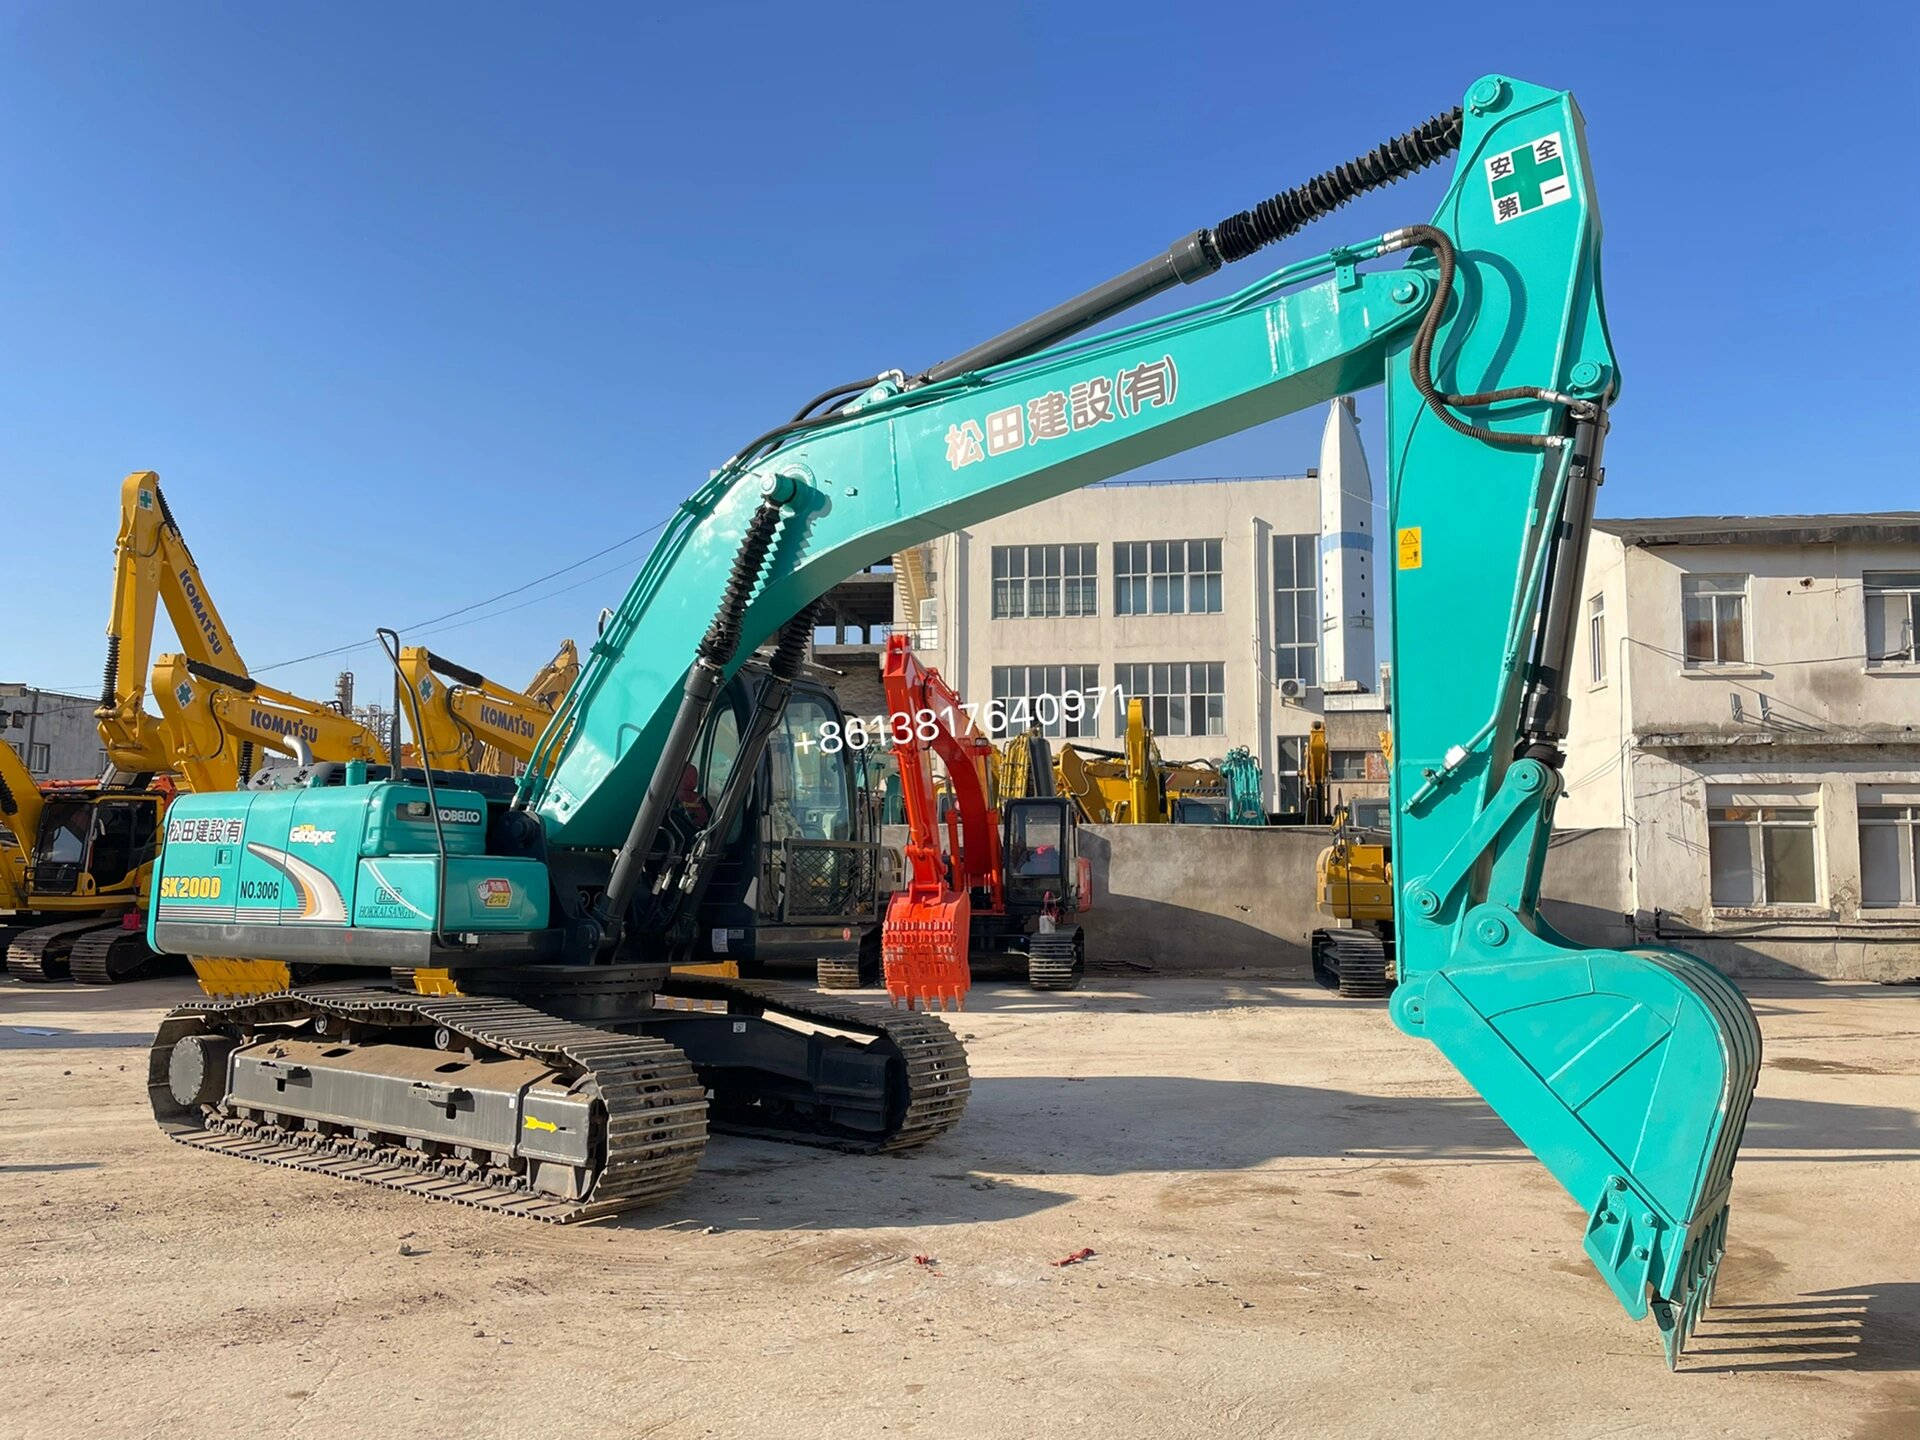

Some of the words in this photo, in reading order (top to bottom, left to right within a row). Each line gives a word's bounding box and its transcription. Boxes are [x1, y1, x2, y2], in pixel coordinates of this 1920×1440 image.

[946, 354, 1178, 470] 松田建設(有)
[179, 569, 223, 655] KOMATSU
[251, 709, 318, 743] KOMATSU
[480, 704, 535, 739] KOMATSU
[168, 818, 244, 844] 松田建設(有)
[240, 880, 279, 900] NO.3006
